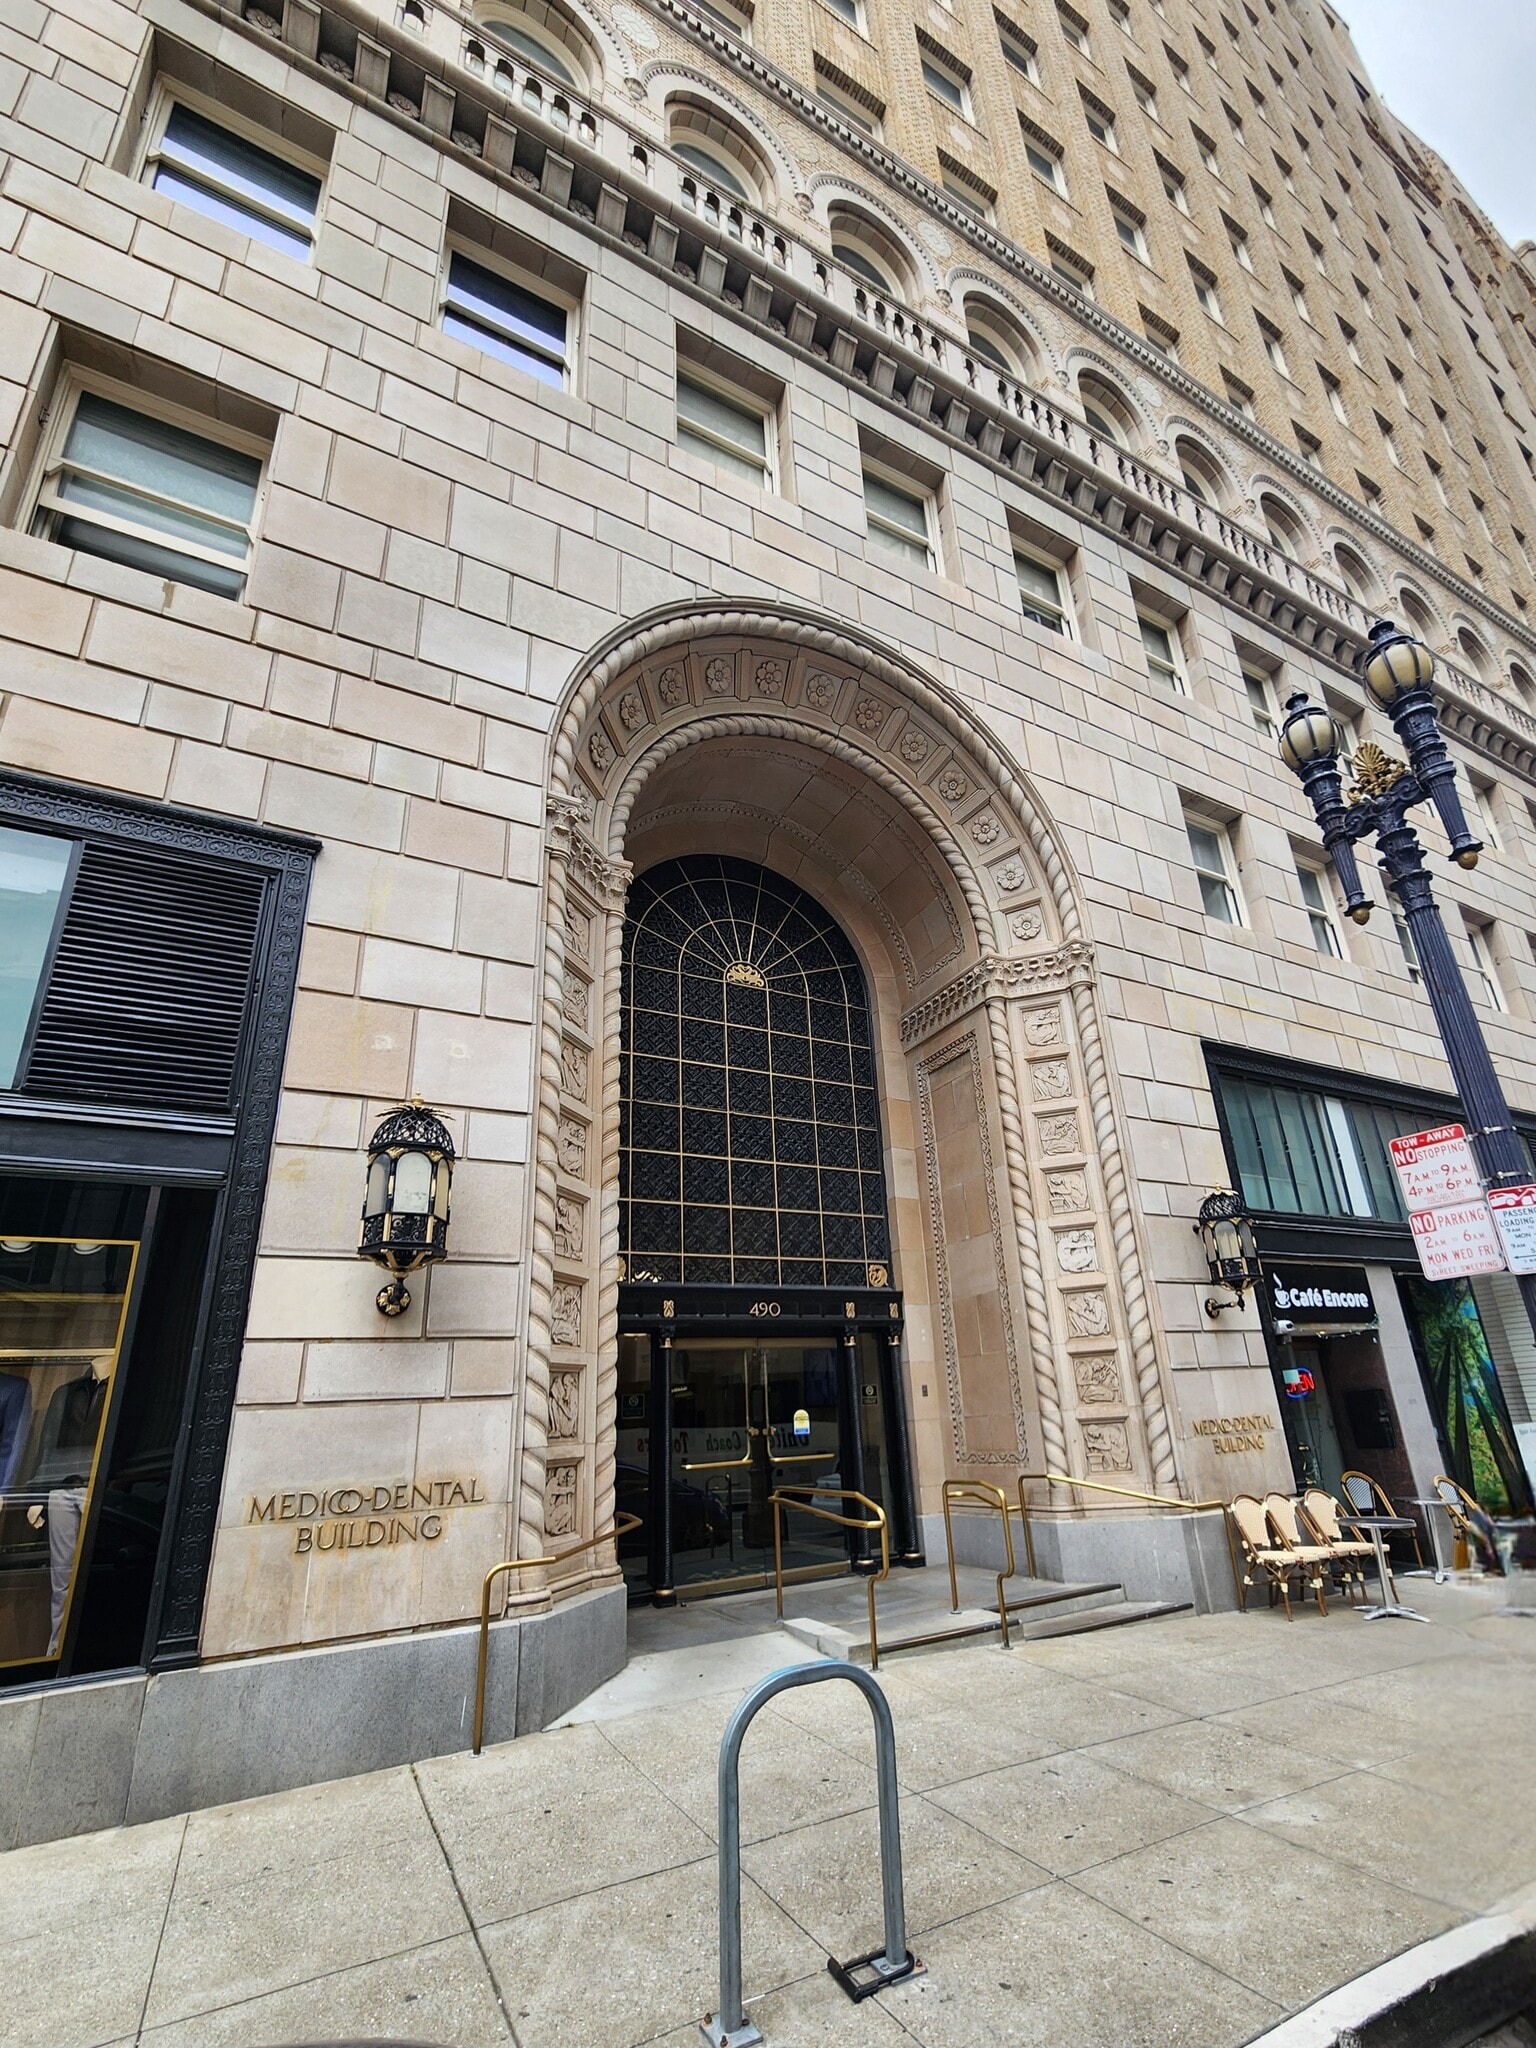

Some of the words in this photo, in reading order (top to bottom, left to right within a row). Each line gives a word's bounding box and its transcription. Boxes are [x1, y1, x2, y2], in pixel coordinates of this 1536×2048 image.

[1394, 1148, 1418, 1166] NO
[1417, 1141, 1465, 1161] STOPPING
[1411, 1213, 1436, 1234] NO
[1437, 1208, 1485, 1228] PARKING
[1499, 1217, 1535, 1227] LOADING
[1427, 1252, 1449, 1265] MON
[1452, 1248, 1474, 1261] WED
[1478, 1244, 1495, 1257] FRI
[1431, 1266, 1457, 1277] STREET
[1461, 1260, 1499, 1273] SWEEPING
[1289, 1287, 1323, 1308] Café
[1322, 1288, 1370, 1308] Encore
[749, 1302, 781, 1317] 490
[1286, 1372, 1315, 1393] EN
[1211, 1434, 1265, 1455] BUILDING
[248, 1477, 486, 1524] MEDICO-DENTAL
[294, 1514, 443, 1554] BUILDING
